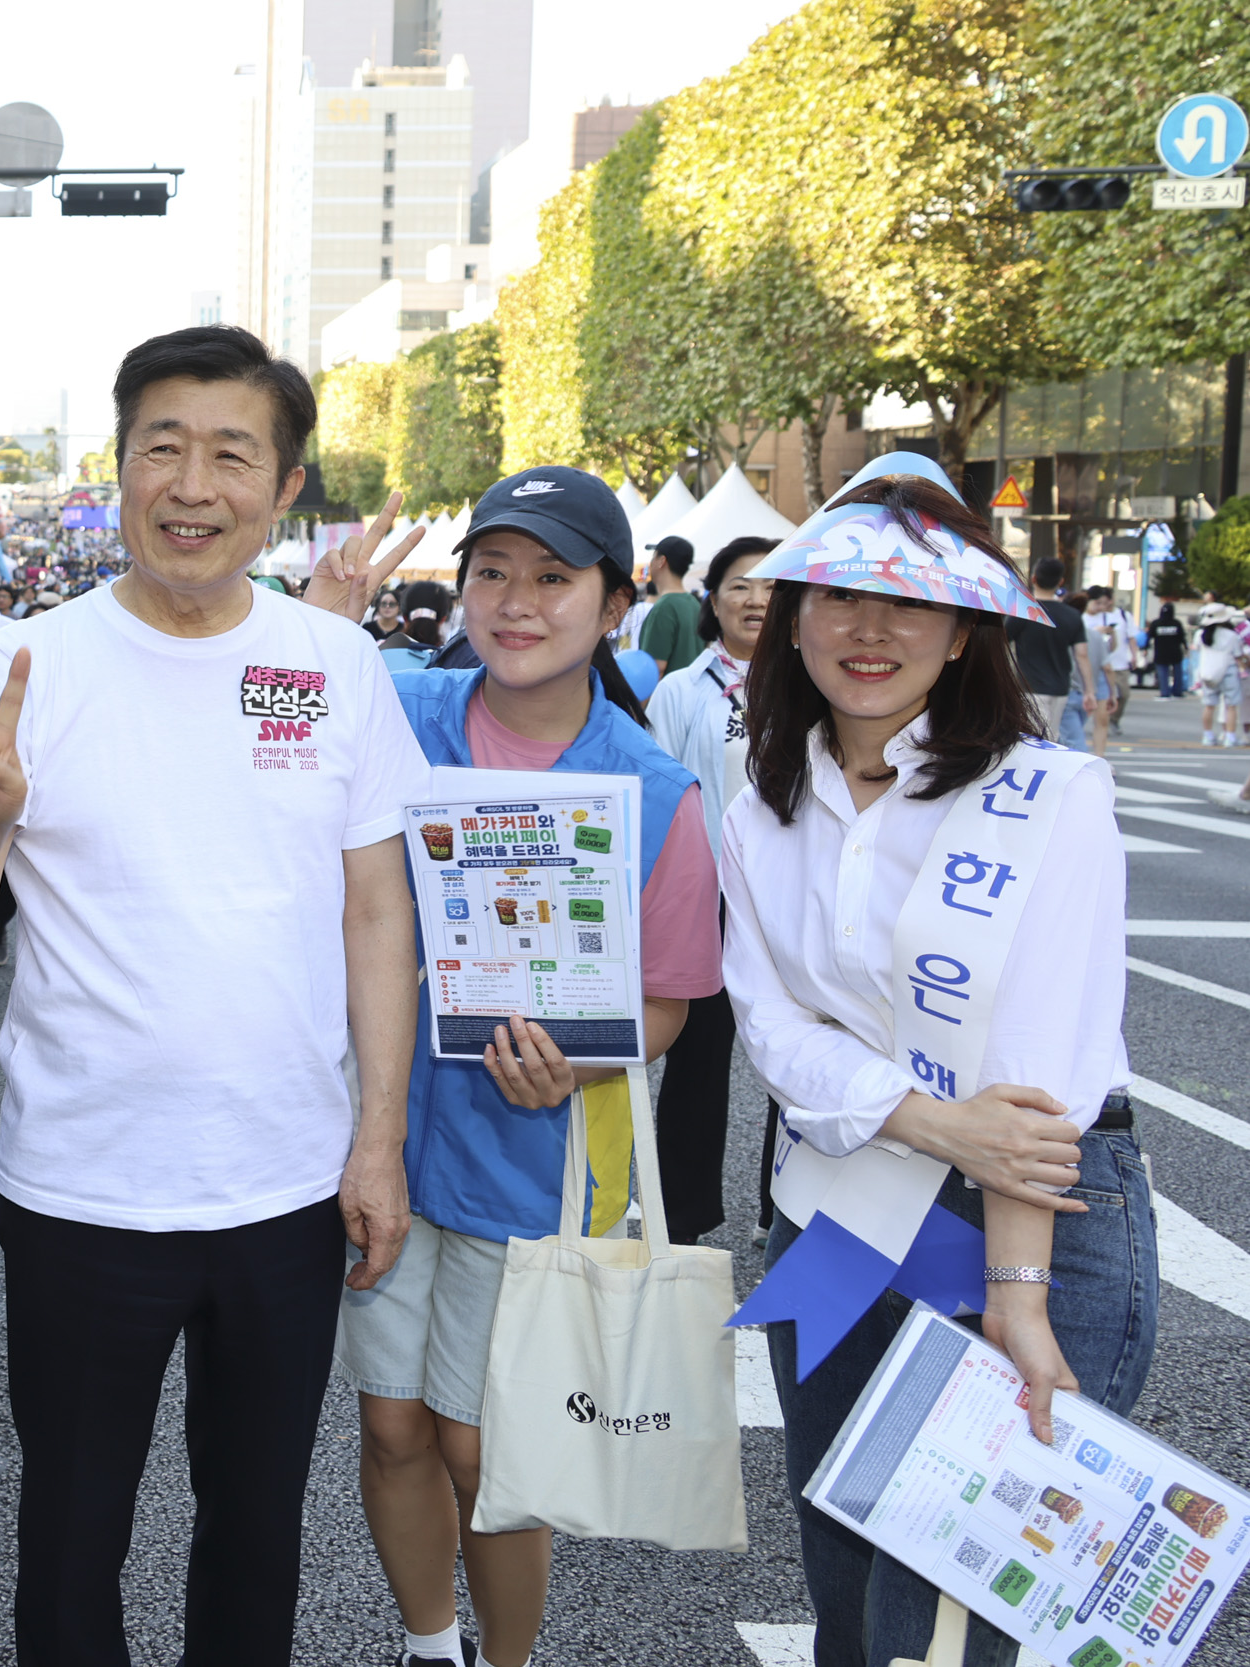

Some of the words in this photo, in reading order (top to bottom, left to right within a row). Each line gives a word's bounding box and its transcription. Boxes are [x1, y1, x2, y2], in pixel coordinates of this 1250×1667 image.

[1159, 184, 1239, 203] 적신호시
[522, 481, 556, 491] NIKE
[833, 563, 883, 573] 서리풀
[889, 565, 923, 577] 뮤직
[928, 570, 991, 598] 페스티벌
[244, 665, 326, 691] 서초구청장
[243, 683, 329, 720] 전성수
[252, 747, 292, 758] SEORIPUL
[294, 748, 318, 759] MUSIC
[254, 759, 291, 770] FESTIVAL
[460, 814, 555, 831] 메가커피와
[463, 829, 557, 845] 네이버페이
[464, 845, 507, 857] 혜택을
[512, 844, 560, 856] 드려요!
[449, 906, 466, 916] SOL
[598, 1410, 671, 1436] 신한은행
[1078, 1442, 1101, 1467] SOL
[1128, 1519, 1171, 1571] 혜택을
[1095, 1566, 1141, 1623] 드려요!
[1114, 1532, 1191, 1634] 네이버페이
[1132, 1545, 1211, 1649] 메가커피와
